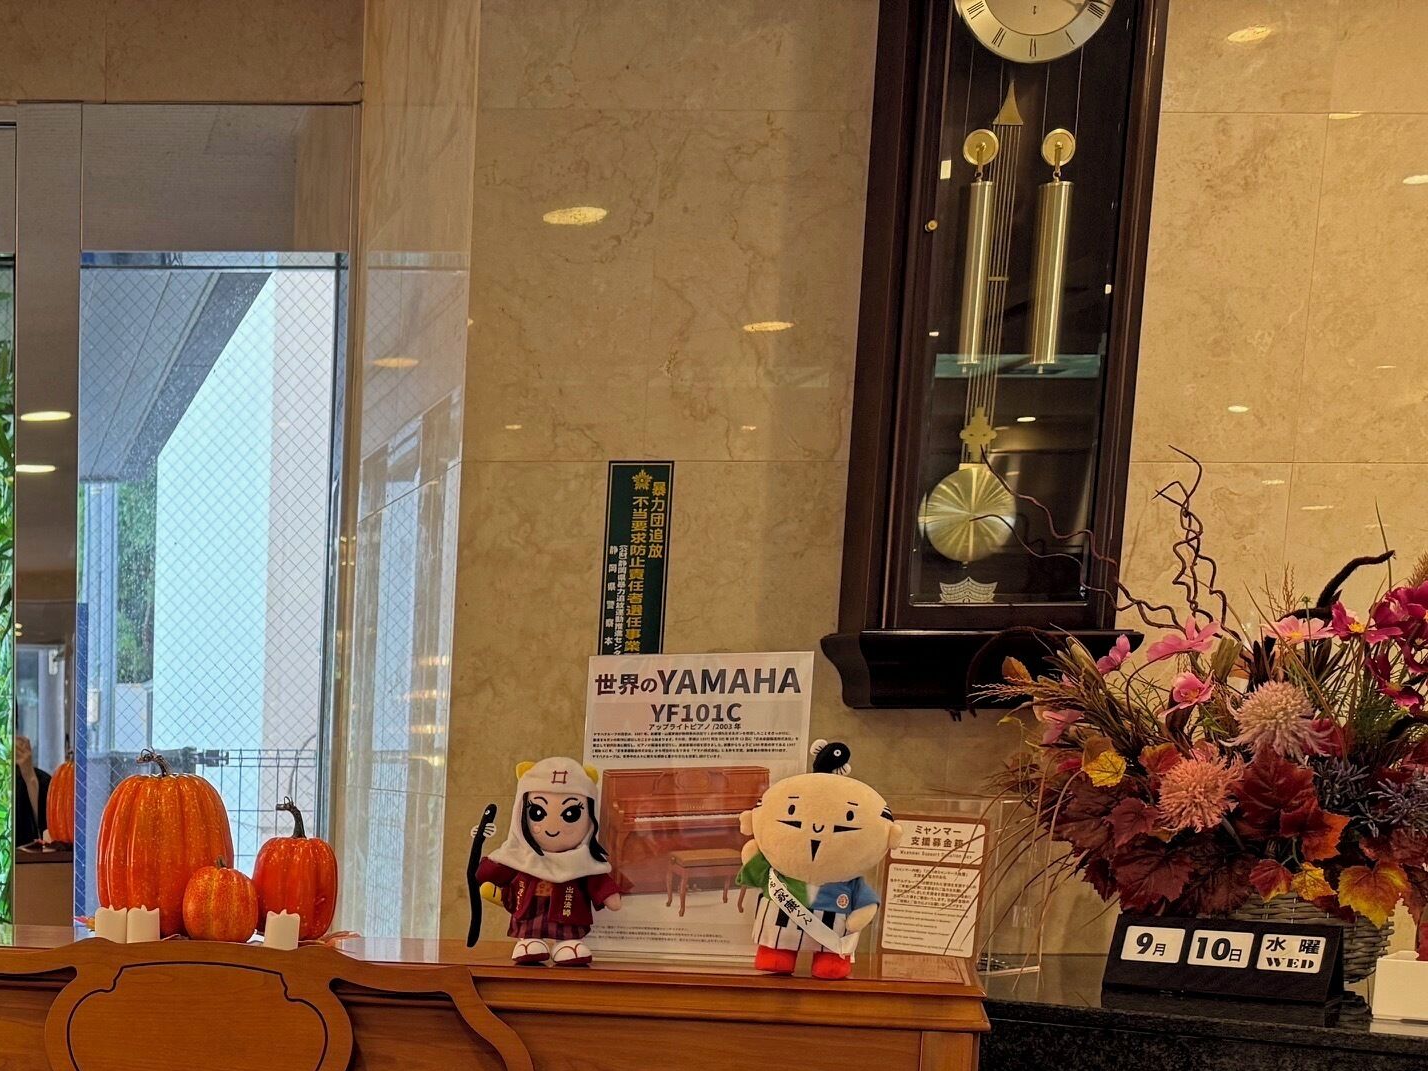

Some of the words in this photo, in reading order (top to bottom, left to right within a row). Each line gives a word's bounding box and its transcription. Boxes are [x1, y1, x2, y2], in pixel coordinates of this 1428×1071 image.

[647, 481, 667, 559] 暴力団追放
[623, 496, 650, 655] 不当要求防止責任者選任事業
[594, 667, 802, 696] 世界のYAMAHA
[650, 702, 742, 723] YF101C
[914, 825, 962, 835] ミャンマー
[1136, 932, 1167, 957] 9月
[1195, 936, 1243, 963] 10日
[1265, 936, 1321, 955] 水曜
[1265, 957, 1315, 969] WED
